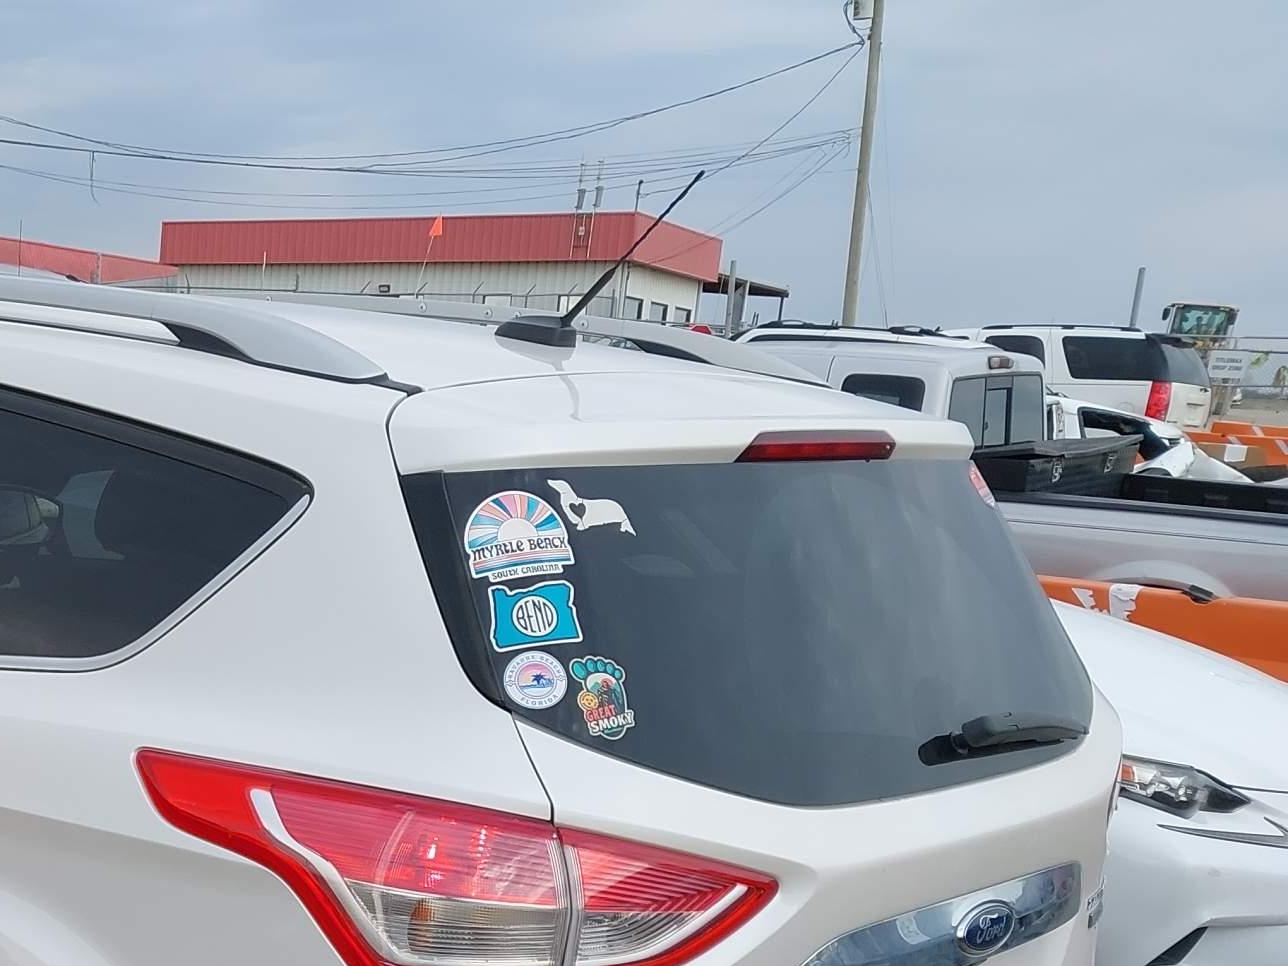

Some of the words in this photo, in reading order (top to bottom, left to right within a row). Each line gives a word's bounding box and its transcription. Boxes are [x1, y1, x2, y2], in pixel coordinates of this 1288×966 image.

[492, 568, 519, 580] SOUTH
[521, 563, 561, 574] CAROLINA
[516, 599, 554, 633] BEND
[539, 655, 563, 676] BEACH
[520, 694, 559, 706] FLORIDA
[586, 704, 617, 721] GREAT
[590, 712, 632, 732] SMOKY
[976, 912, 1008, 944] Ford
